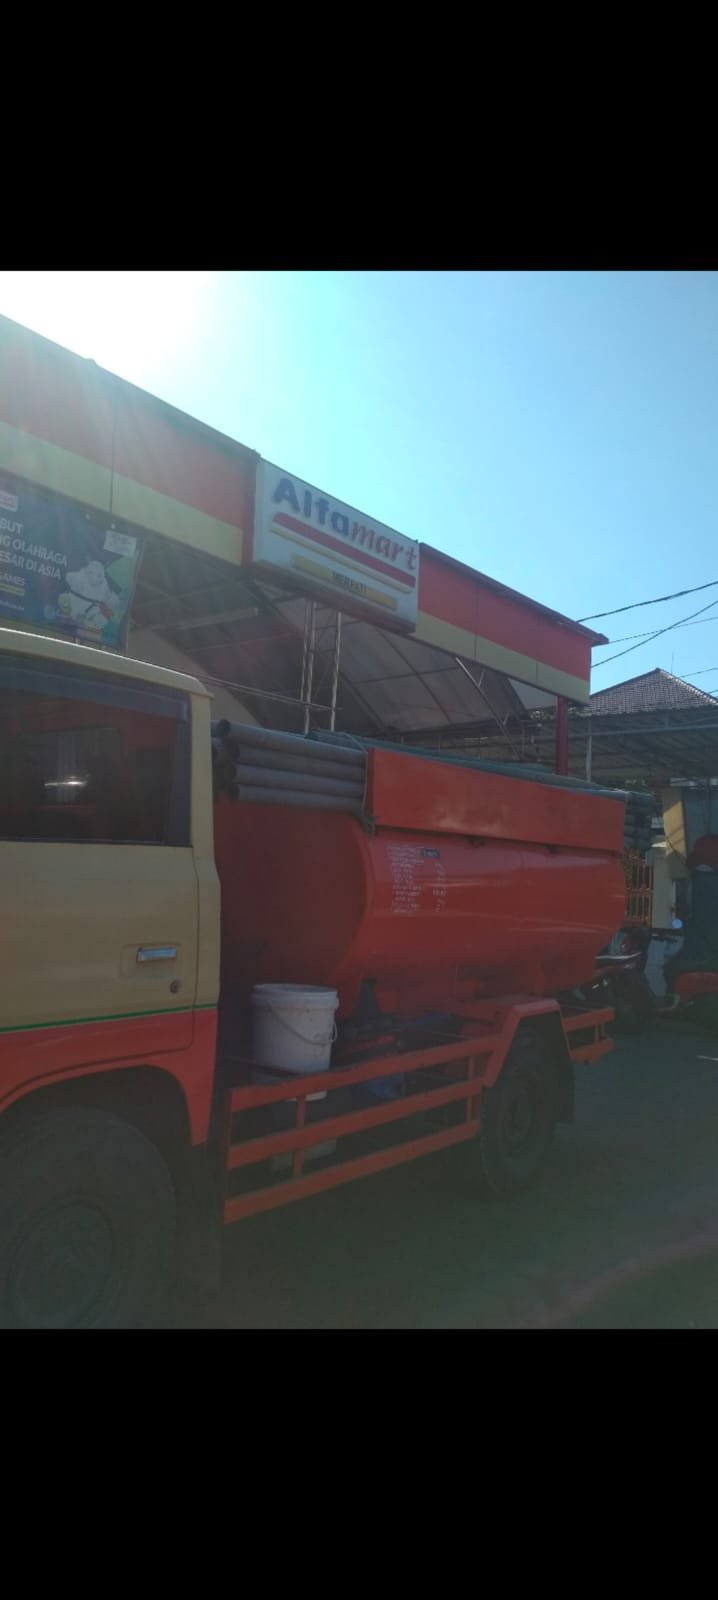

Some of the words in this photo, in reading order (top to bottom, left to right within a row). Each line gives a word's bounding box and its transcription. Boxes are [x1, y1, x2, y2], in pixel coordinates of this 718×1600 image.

[272, 477, 417, 570] Alfamart
[12, 539, 68, 568] OLAHRAGA
[26, 559, 38, 572] DI
[38, 563, 62, 580] ASIA
